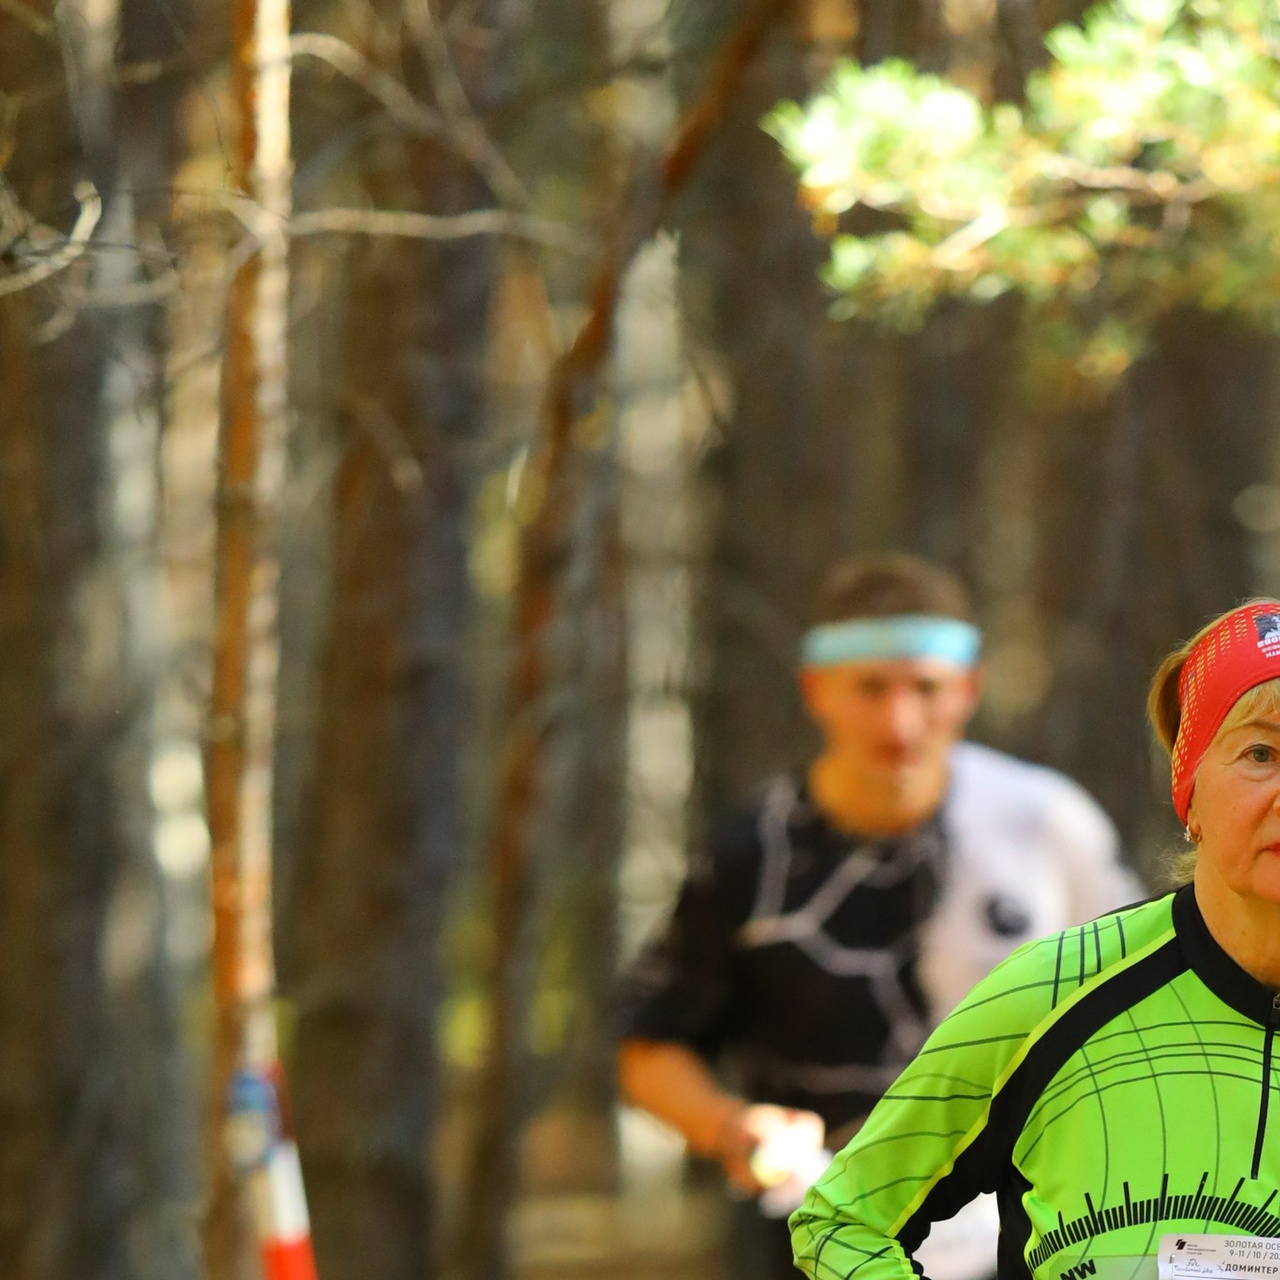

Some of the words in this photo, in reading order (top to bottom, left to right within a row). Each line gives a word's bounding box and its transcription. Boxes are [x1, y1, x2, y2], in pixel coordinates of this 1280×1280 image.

[1224, 1240, 1264, 1250] ЗОЛОТАЯ
[1253, 1251, 1261, 1259] 10
[1225, 1263, 1279, 1275] ДОМИНТЕР
